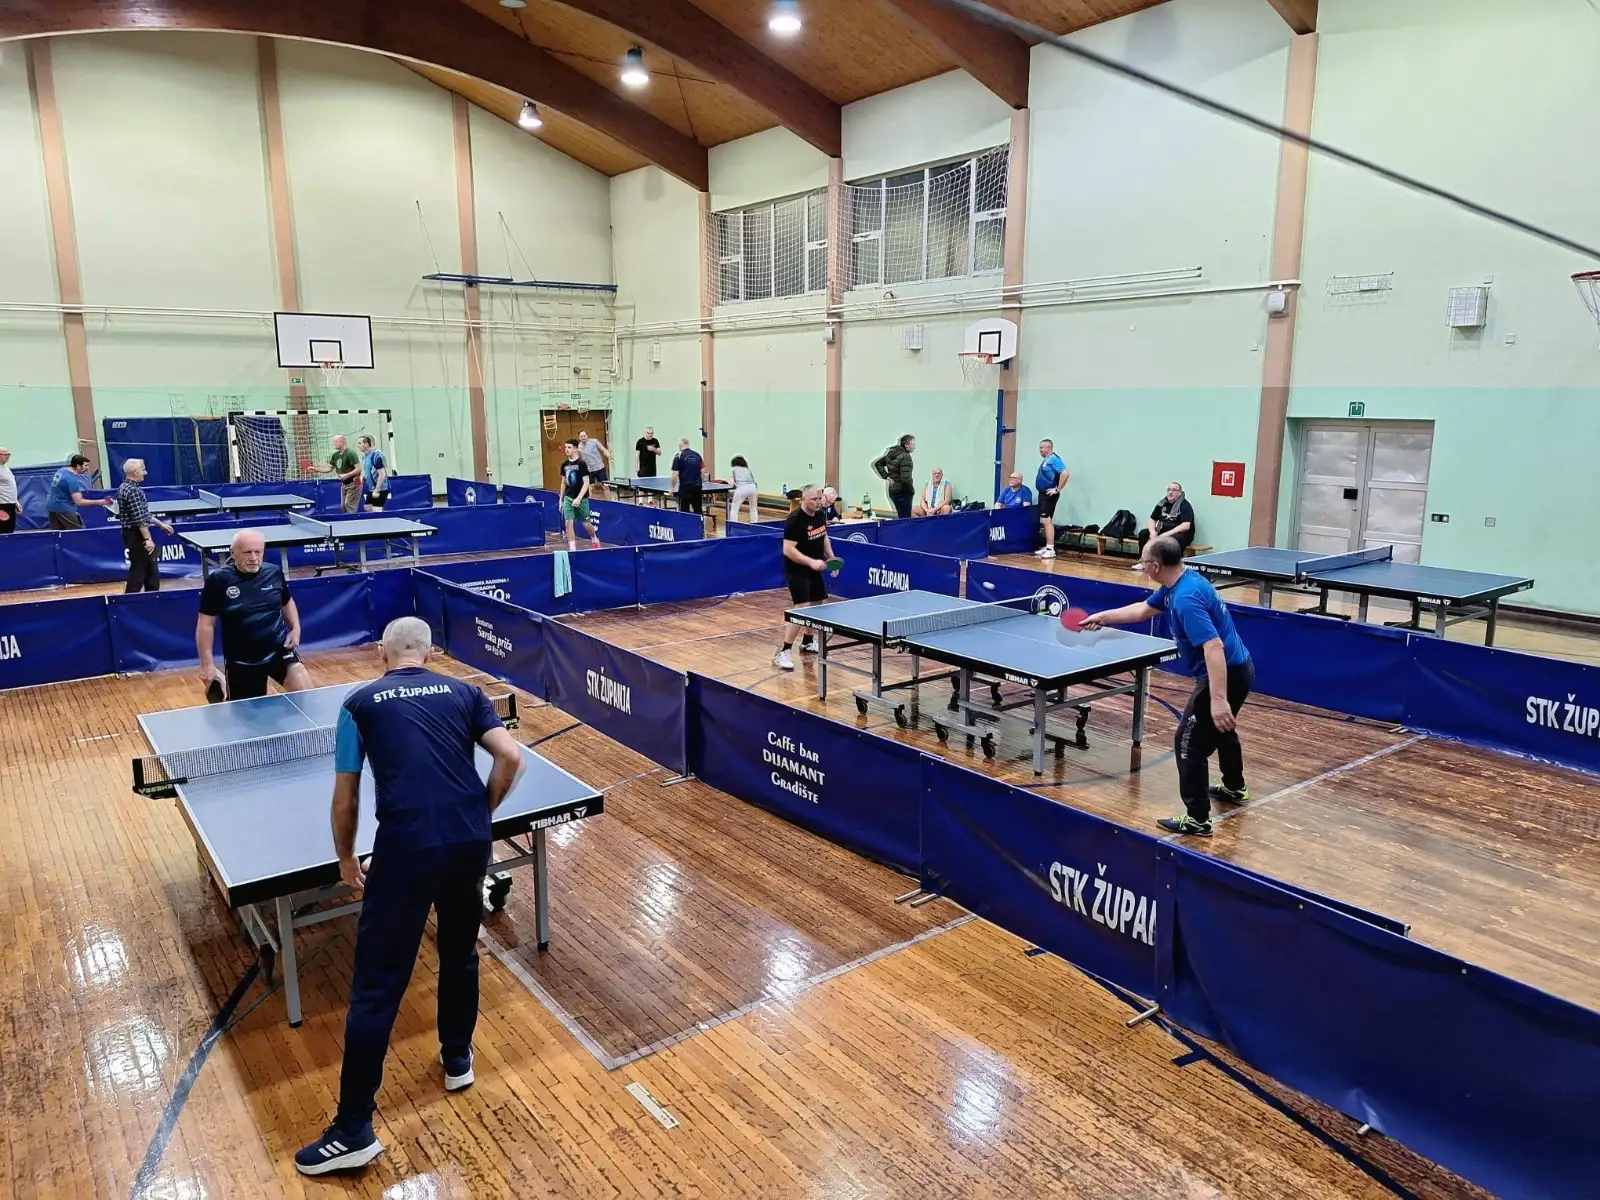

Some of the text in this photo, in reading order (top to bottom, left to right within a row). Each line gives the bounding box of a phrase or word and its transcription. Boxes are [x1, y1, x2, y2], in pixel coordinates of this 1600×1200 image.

[868, 563, 910, 592] STK ŽUPANJA
[1417, 596, 1441, 605] TIBHAR
[477, 626, 497, 644] Savska
[586, 665, 631, 715] STK ŽUPANJA
[1004, 672, 1029, 686] TIBHAR
[373, 684, 452, 703] STK ŽUPANJA
[1526, 692, 1600, 739] STK ŽUP
[762, 748, 825, 786] DIJAMANT
[529, 812, 571, 831] TIBHAR
[1049, 861, 1089, 917] STK
